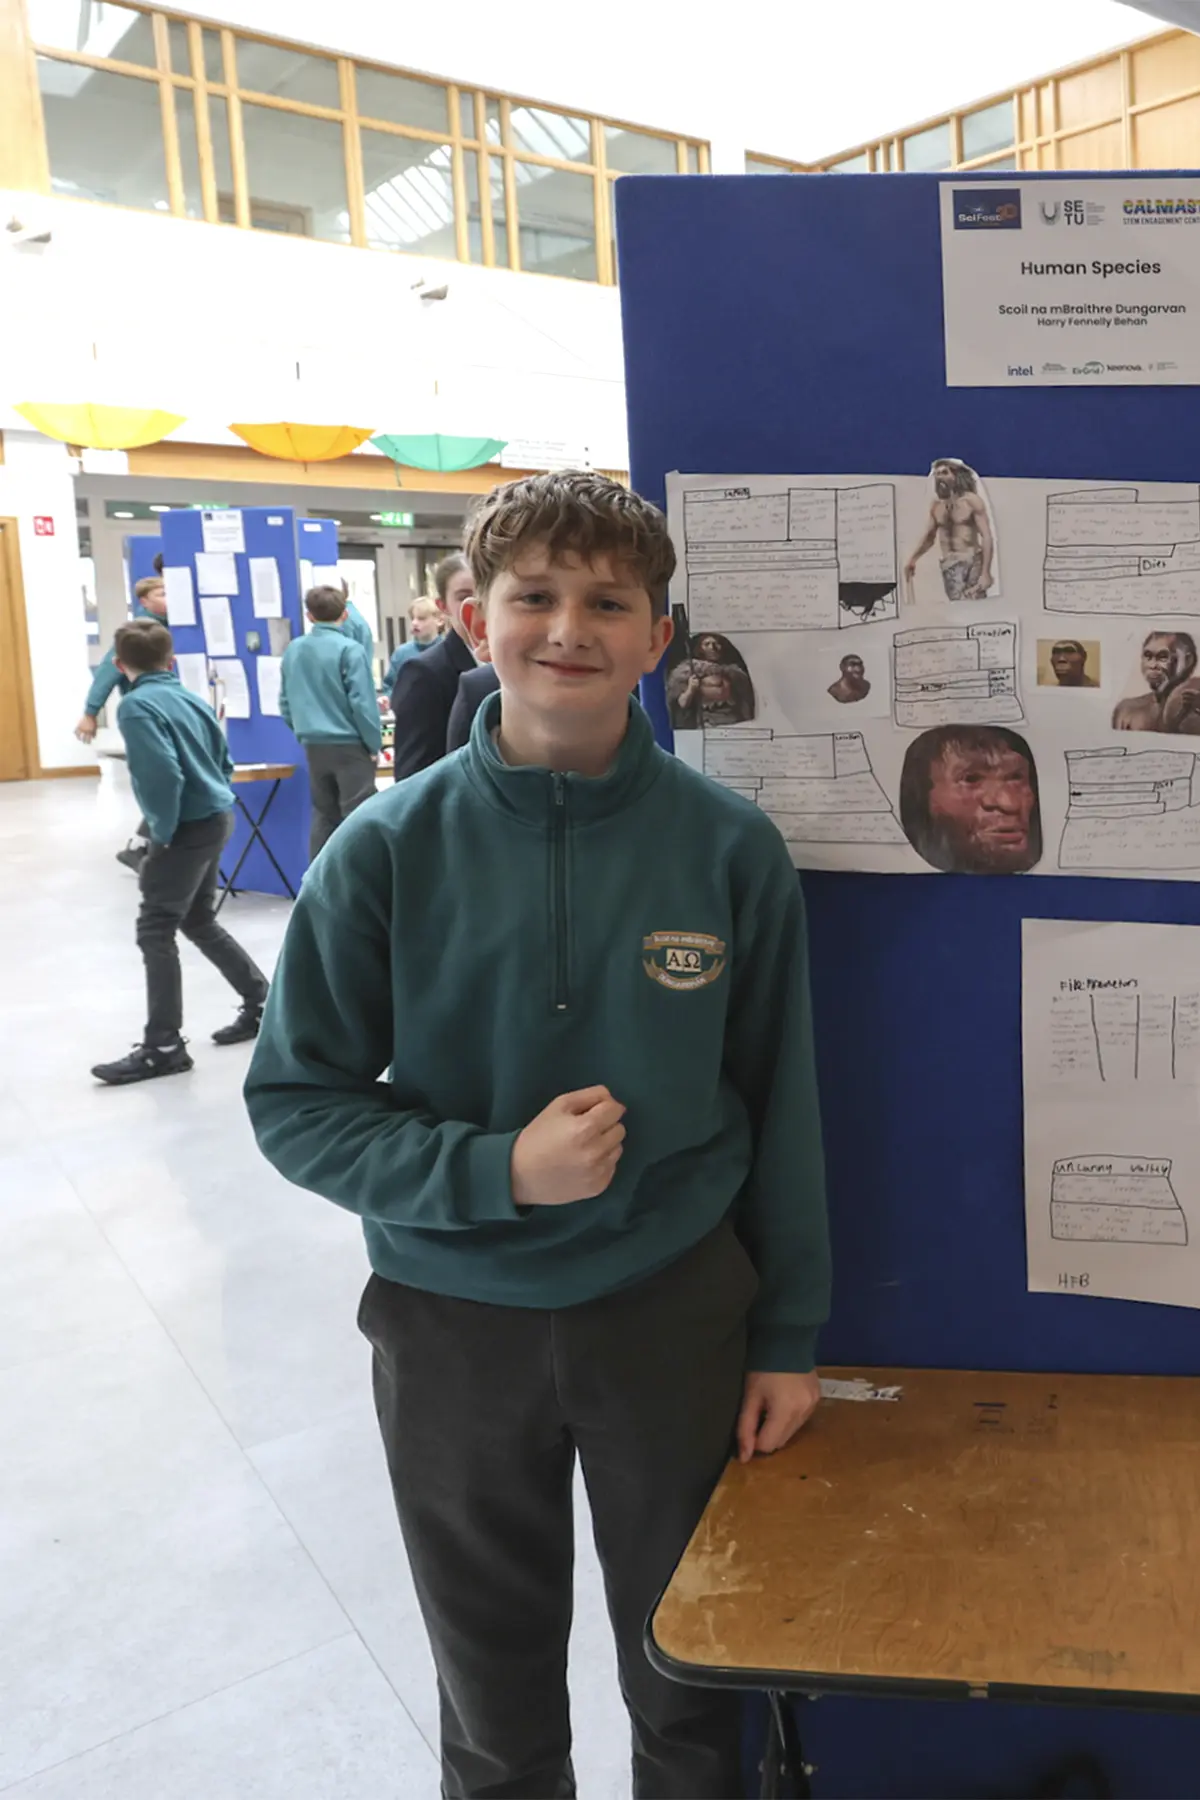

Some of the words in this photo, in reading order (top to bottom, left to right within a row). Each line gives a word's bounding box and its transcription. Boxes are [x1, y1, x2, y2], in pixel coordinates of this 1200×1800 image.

[1021, 261, 1087, 275] Human
[1091, 260, 1161, 278] Species
[999, 304, 1028, 315] Scoil
[1031, 306, 1047, 315] na
[1050, 303, 1112, 315] mBraithre
[1115, 303, 1186, 316] Dungarvan
[1037, 317, 1066, 328] Harry
[1068, 316, 1112, 328] Fennelly
[1114, 317, 1148, 327] Behan
[1007, 365, 1034, 376] intel
